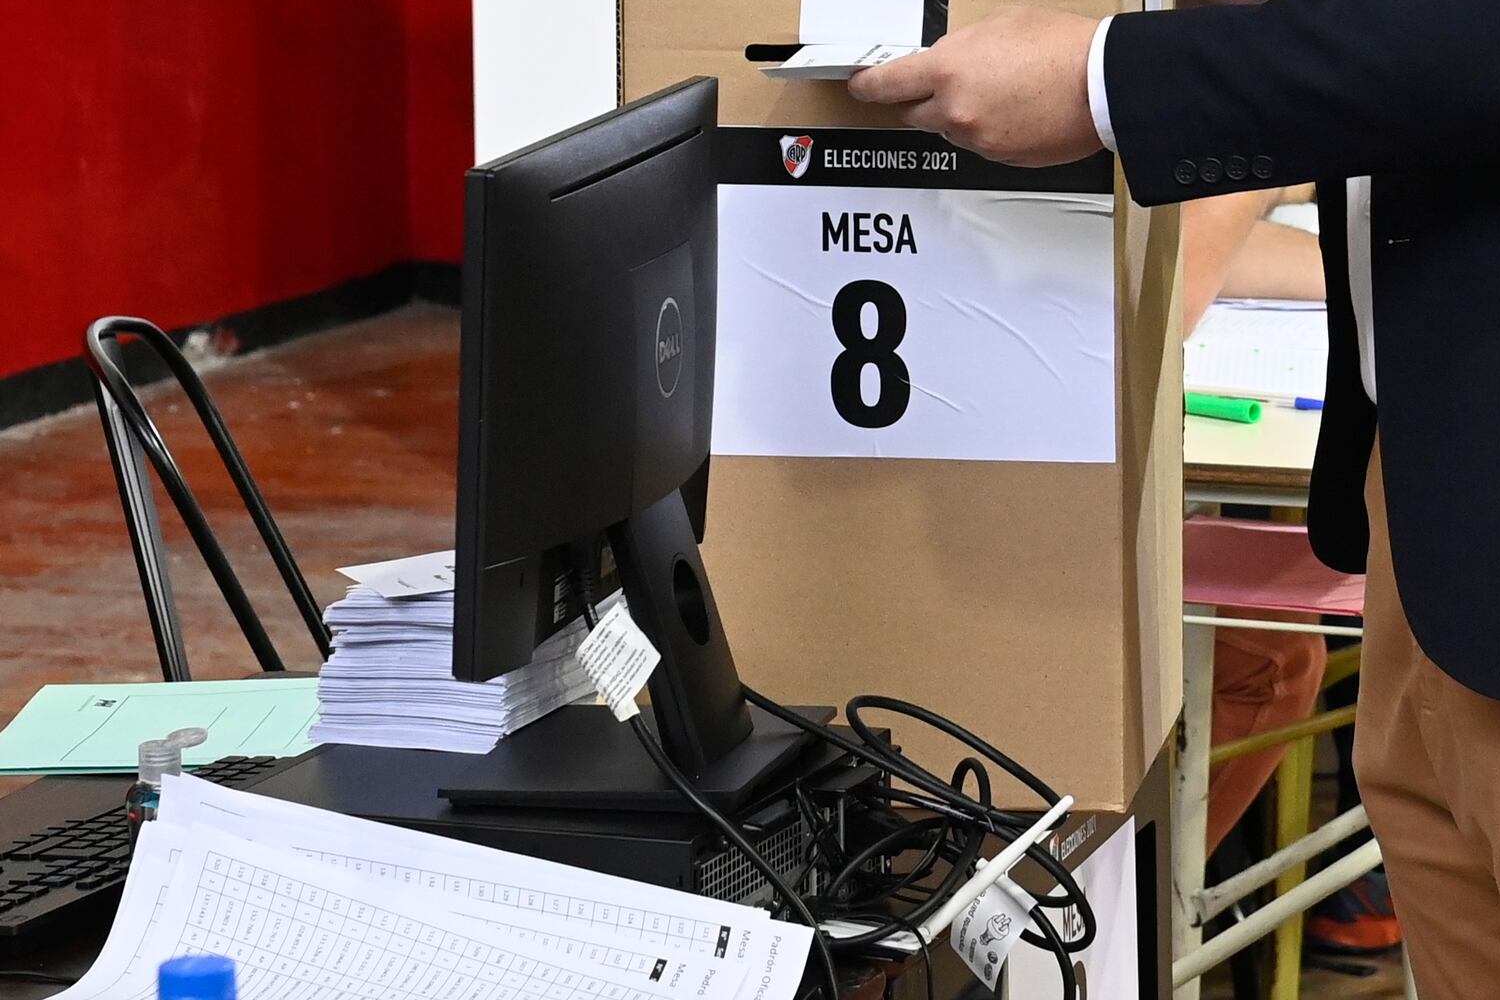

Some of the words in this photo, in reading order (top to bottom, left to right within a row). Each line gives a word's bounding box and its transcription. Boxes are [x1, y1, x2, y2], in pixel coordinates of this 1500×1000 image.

[824, 149, 917, 170] ELECCIONES
[922, 151, 957, 171] 2021
[821, 212, 918, 254] MESA
[659, 333, 681, 364] DELL
[830, 279, 911, 429] 8
